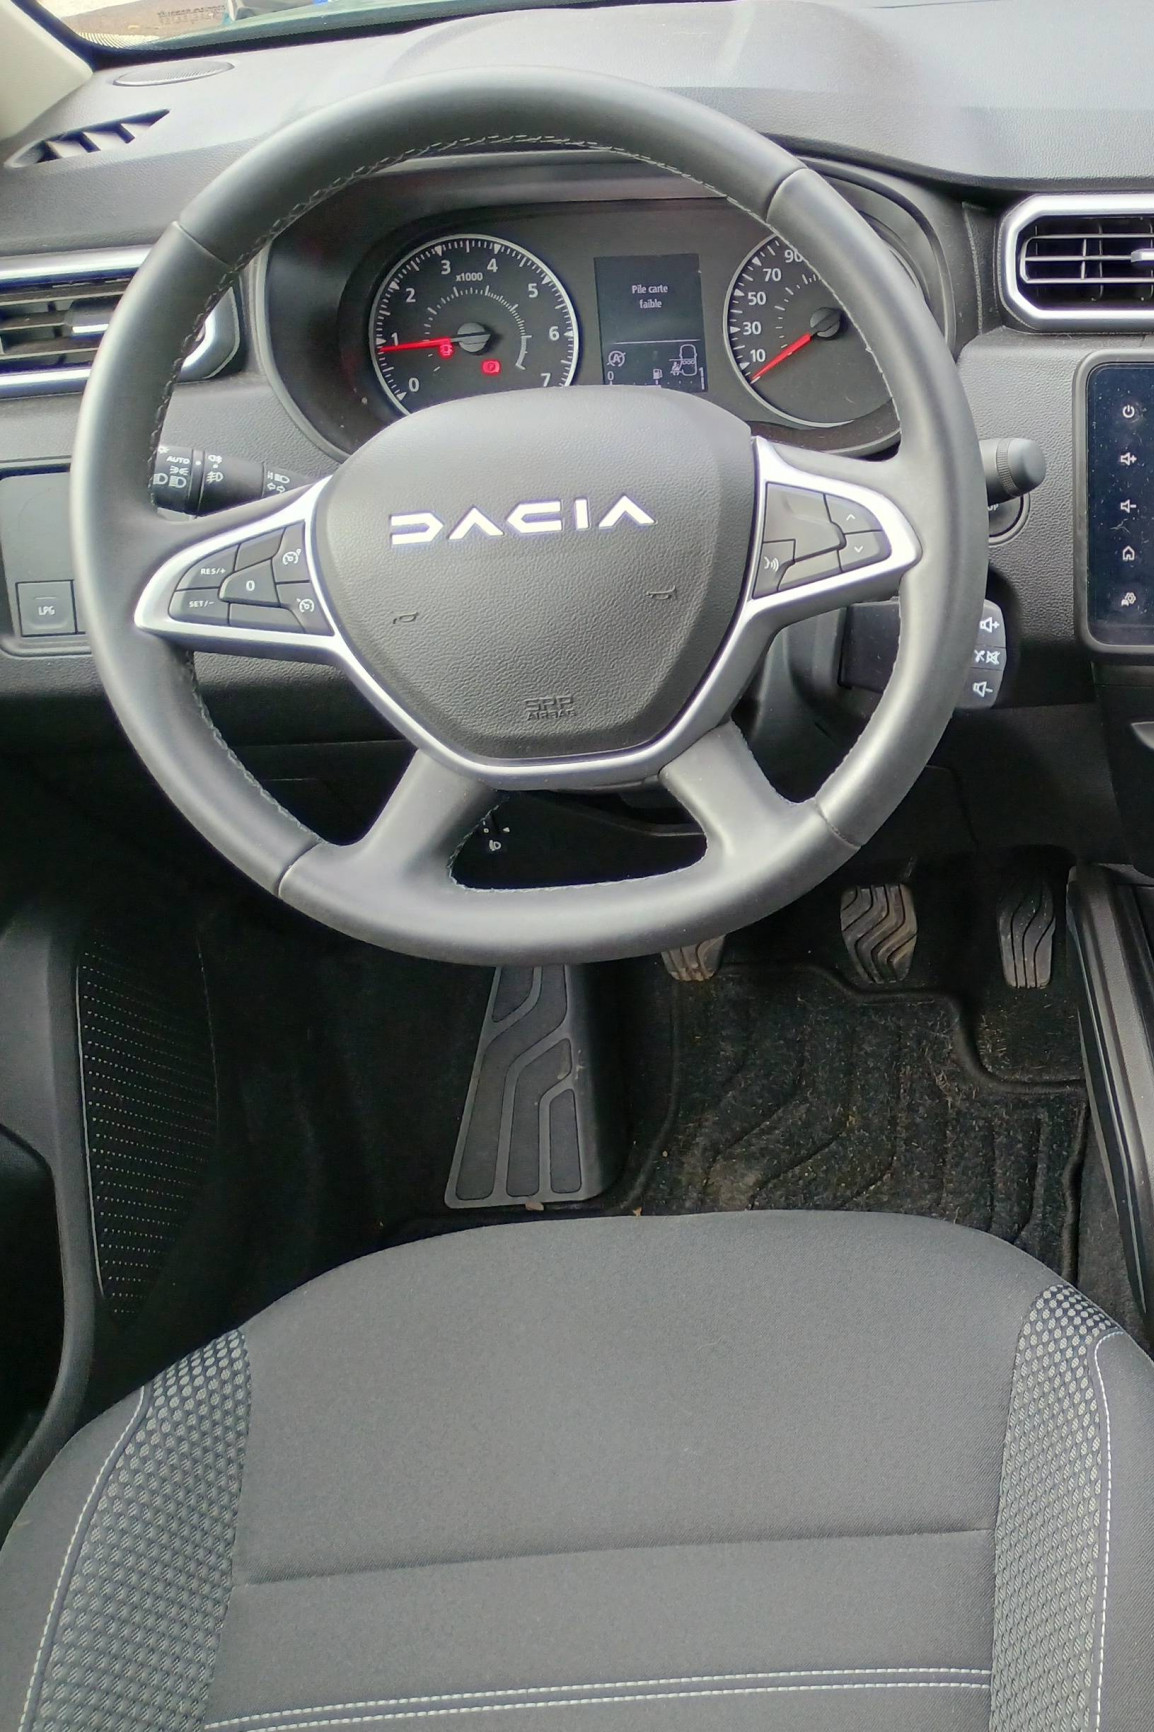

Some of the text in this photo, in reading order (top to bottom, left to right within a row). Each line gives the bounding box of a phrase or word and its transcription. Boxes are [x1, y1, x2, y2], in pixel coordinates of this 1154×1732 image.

[784, 250, 803, 263] 90
[441, 260, 451, 275] 3
[487, 258, 498, 273] 4
[455, 272, 483, 282] x1000
[763, 268, 782, 281] 70
[405, 288, 416, 303] 2
[528, 283, 539, 298] 5
[631, 284, 668, 294] Pile carte
[639, 299, 662, 309] faible
[747, 292, 767, 305] 50
[549, 326, 560, 341] 6
[743, 322, 761, 335] 30
[391, 332, 399, 346] 1
[750, 349, 766, 362] 10
[409, 377, 420, 392] 0
[540, 373, 551, 387] 7
[167, 455, 190, 464] AUTO
[390, 495, 657, 545] DACIA
